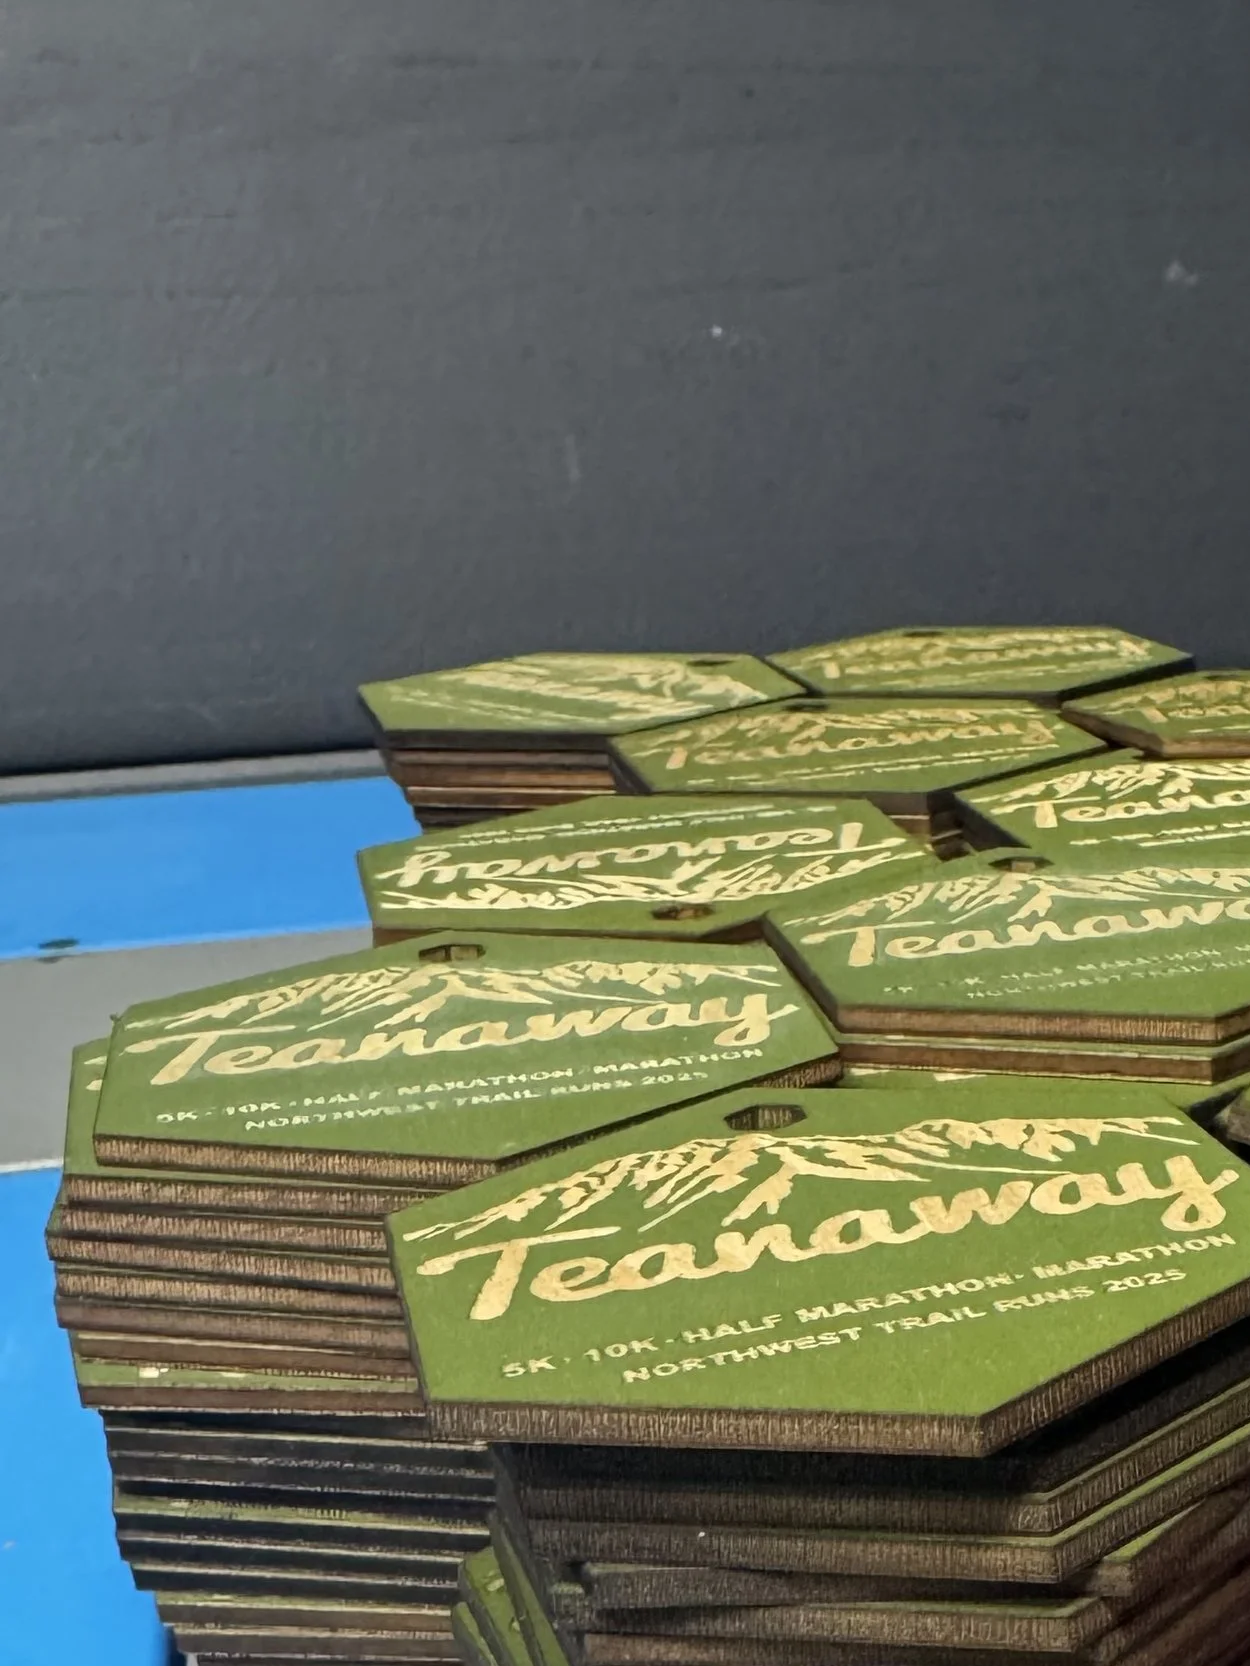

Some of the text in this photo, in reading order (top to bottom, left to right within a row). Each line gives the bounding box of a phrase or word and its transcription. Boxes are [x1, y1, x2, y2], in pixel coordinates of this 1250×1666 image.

[374, 823, 908, 888] Teanaway
[124, 993, 800, 1085] Teanaway
[397, 1068, 574, 1096] MARATHON
[593, 1047, 764, 1074] MARATHON
[416, 1155, 1240, 1321] Teanaway
[502, 1232, 1236, 1378] 5K 10K HALF MARATHON MARATHON
[623, 1268, 1188, 1384] NORTHWEST TRAIL RUNS 2025
